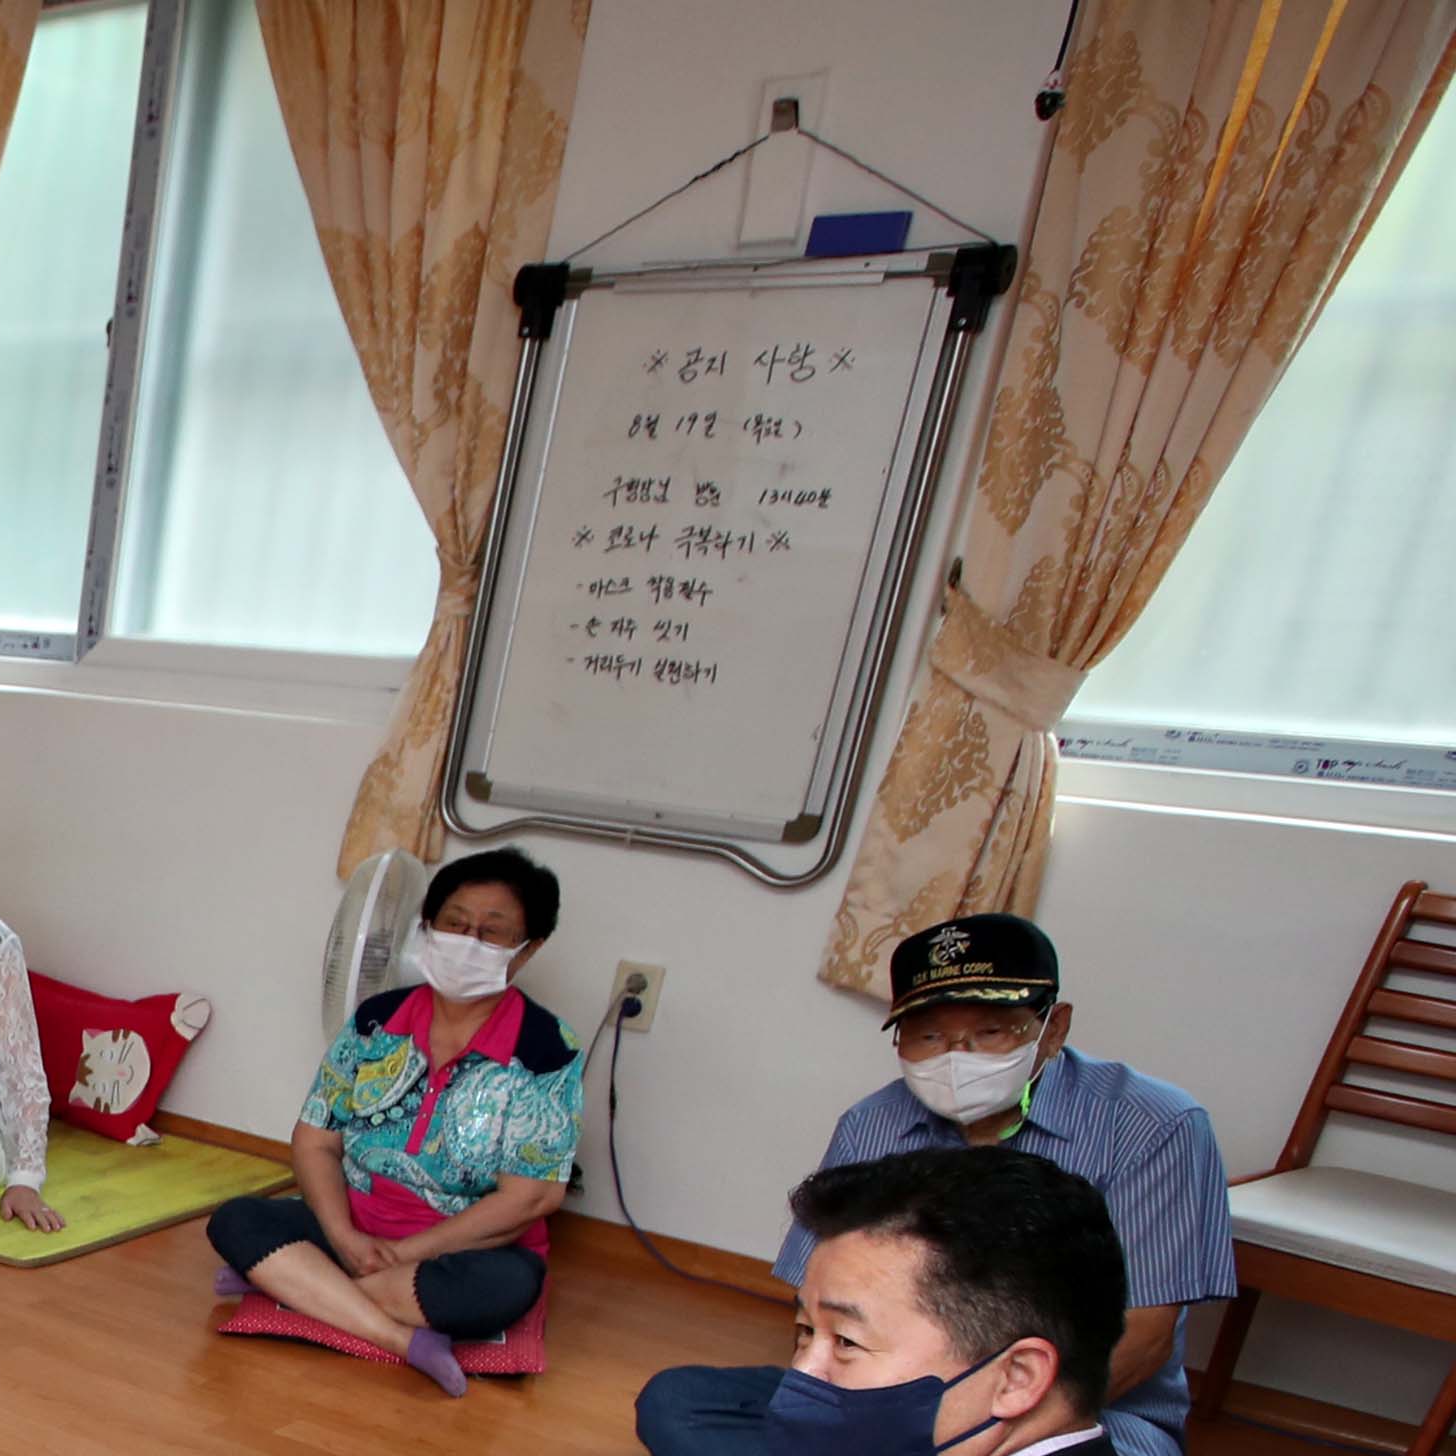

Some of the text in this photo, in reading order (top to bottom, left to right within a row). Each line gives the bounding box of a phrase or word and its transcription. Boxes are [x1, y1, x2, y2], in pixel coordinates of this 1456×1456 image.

[677, 341, 817, 385] 공지 사항
[628, 412, 661, 439] 8월
[603, 524, 755, 560] 코로나 극복하기
[589, 576, 633, 599] 마스크
[585, 615, 689, 642] 손 자주 씻기
[584, 653, 718, 686] 거리두기 실천하기
[962, 962, 994, 975] CORPS
